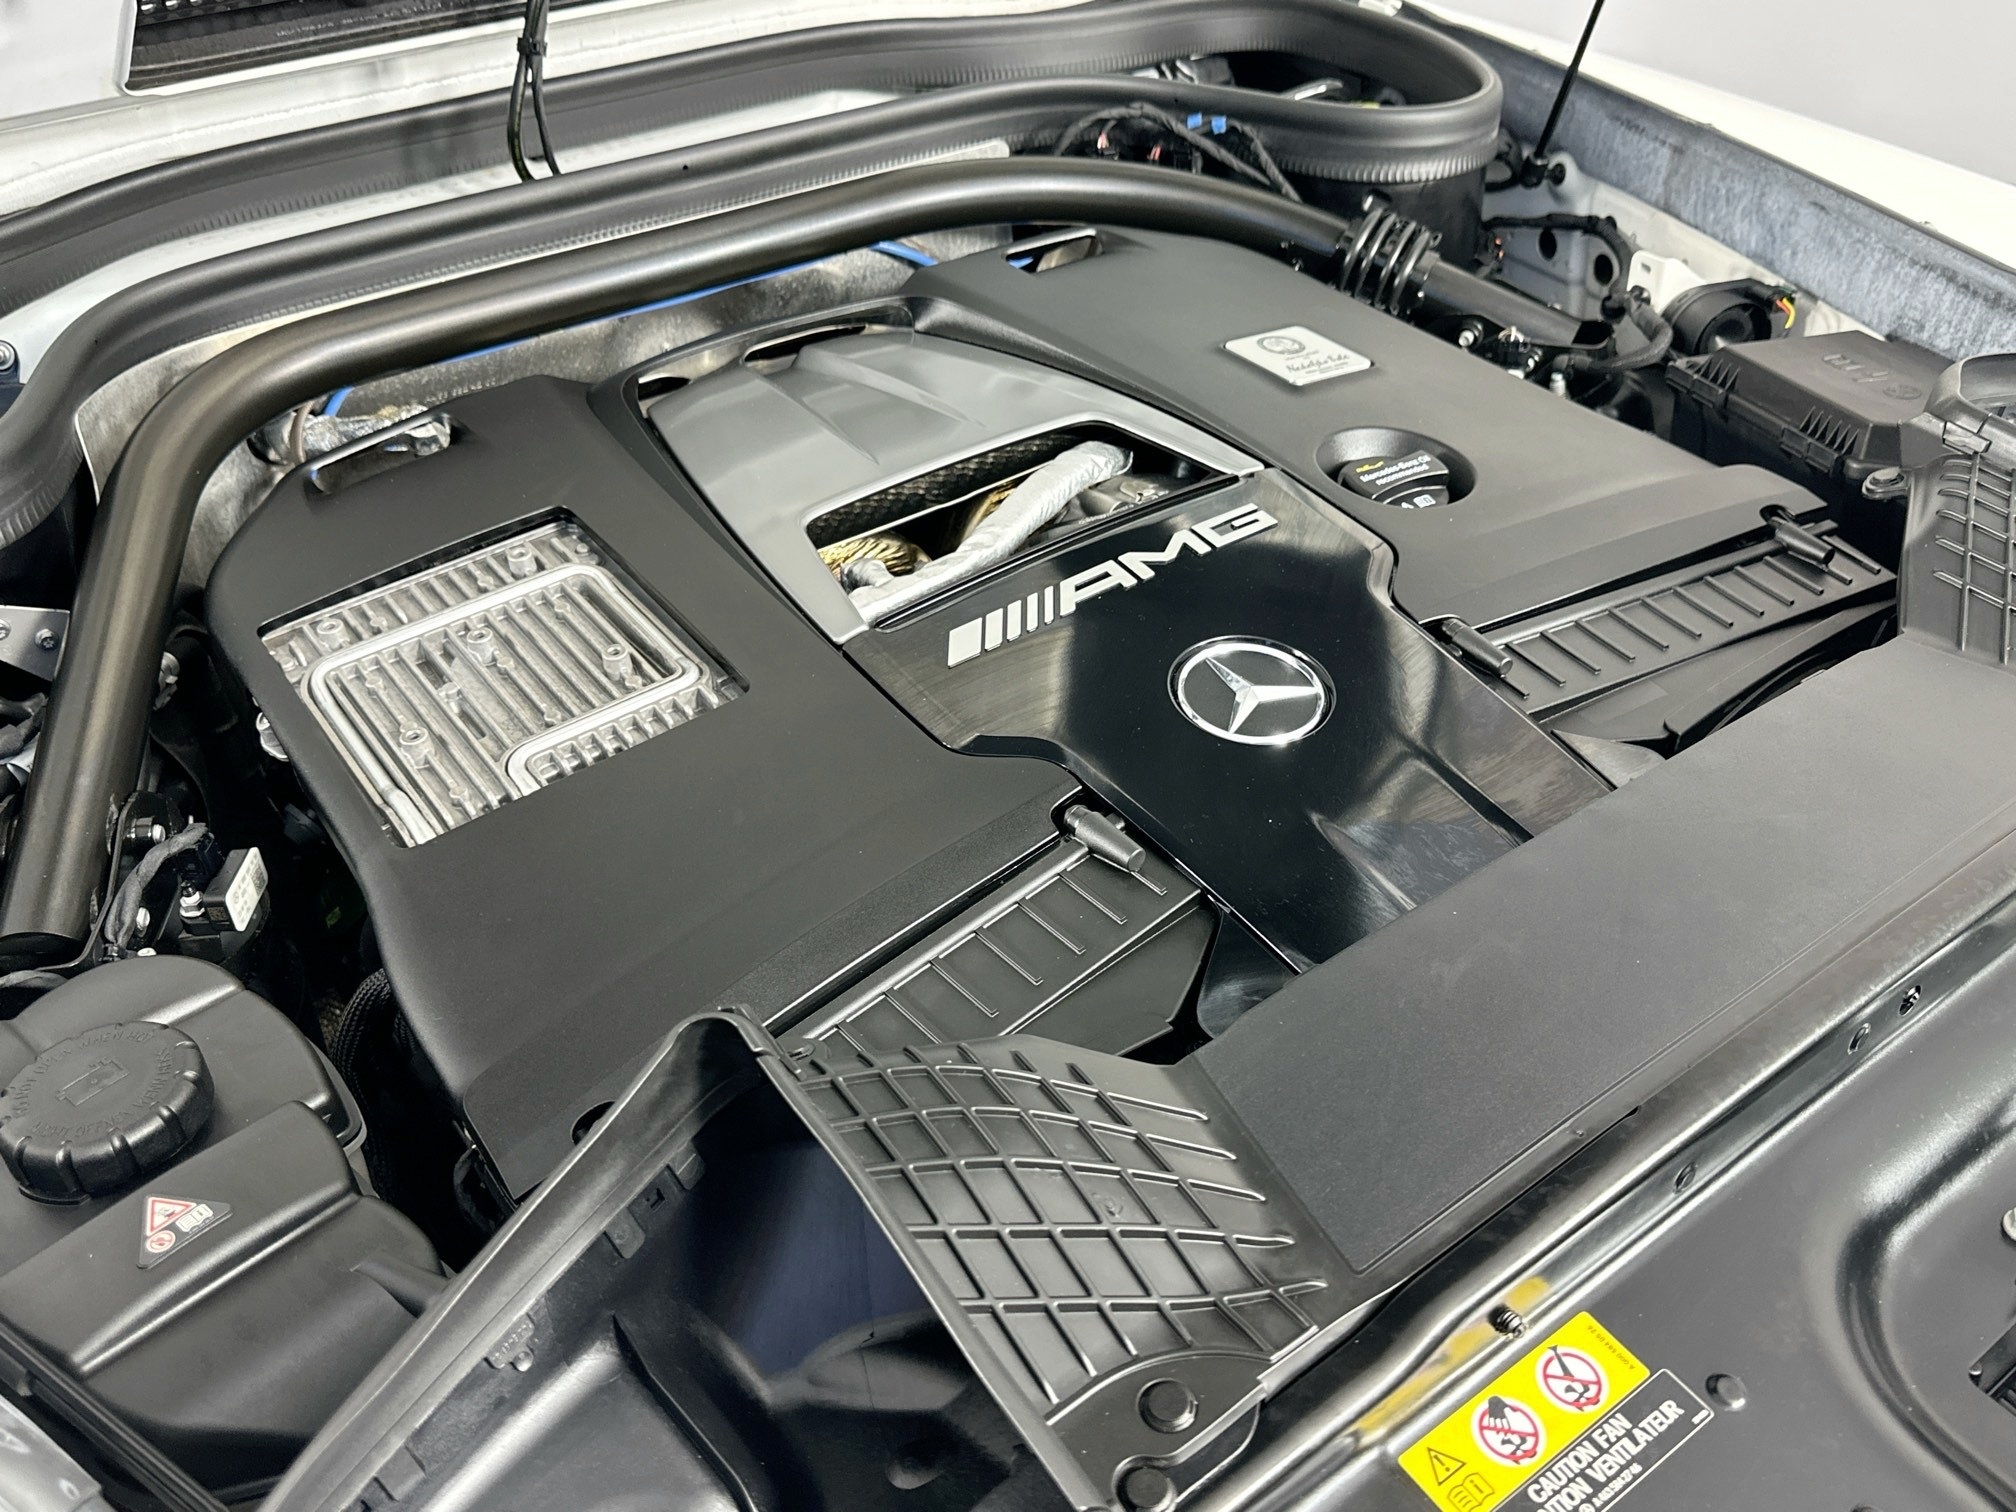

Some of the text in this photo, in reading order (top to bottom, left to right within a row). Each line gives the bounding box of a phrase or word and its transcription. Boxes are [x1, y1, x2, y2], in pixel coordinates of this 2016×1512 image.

[1060, 502, 1278, 618] AMG
[1527, 1412, 1633, 1503] CAUTION FAN
[1585, 1400, 1685, 1483] VENTILATEUR
